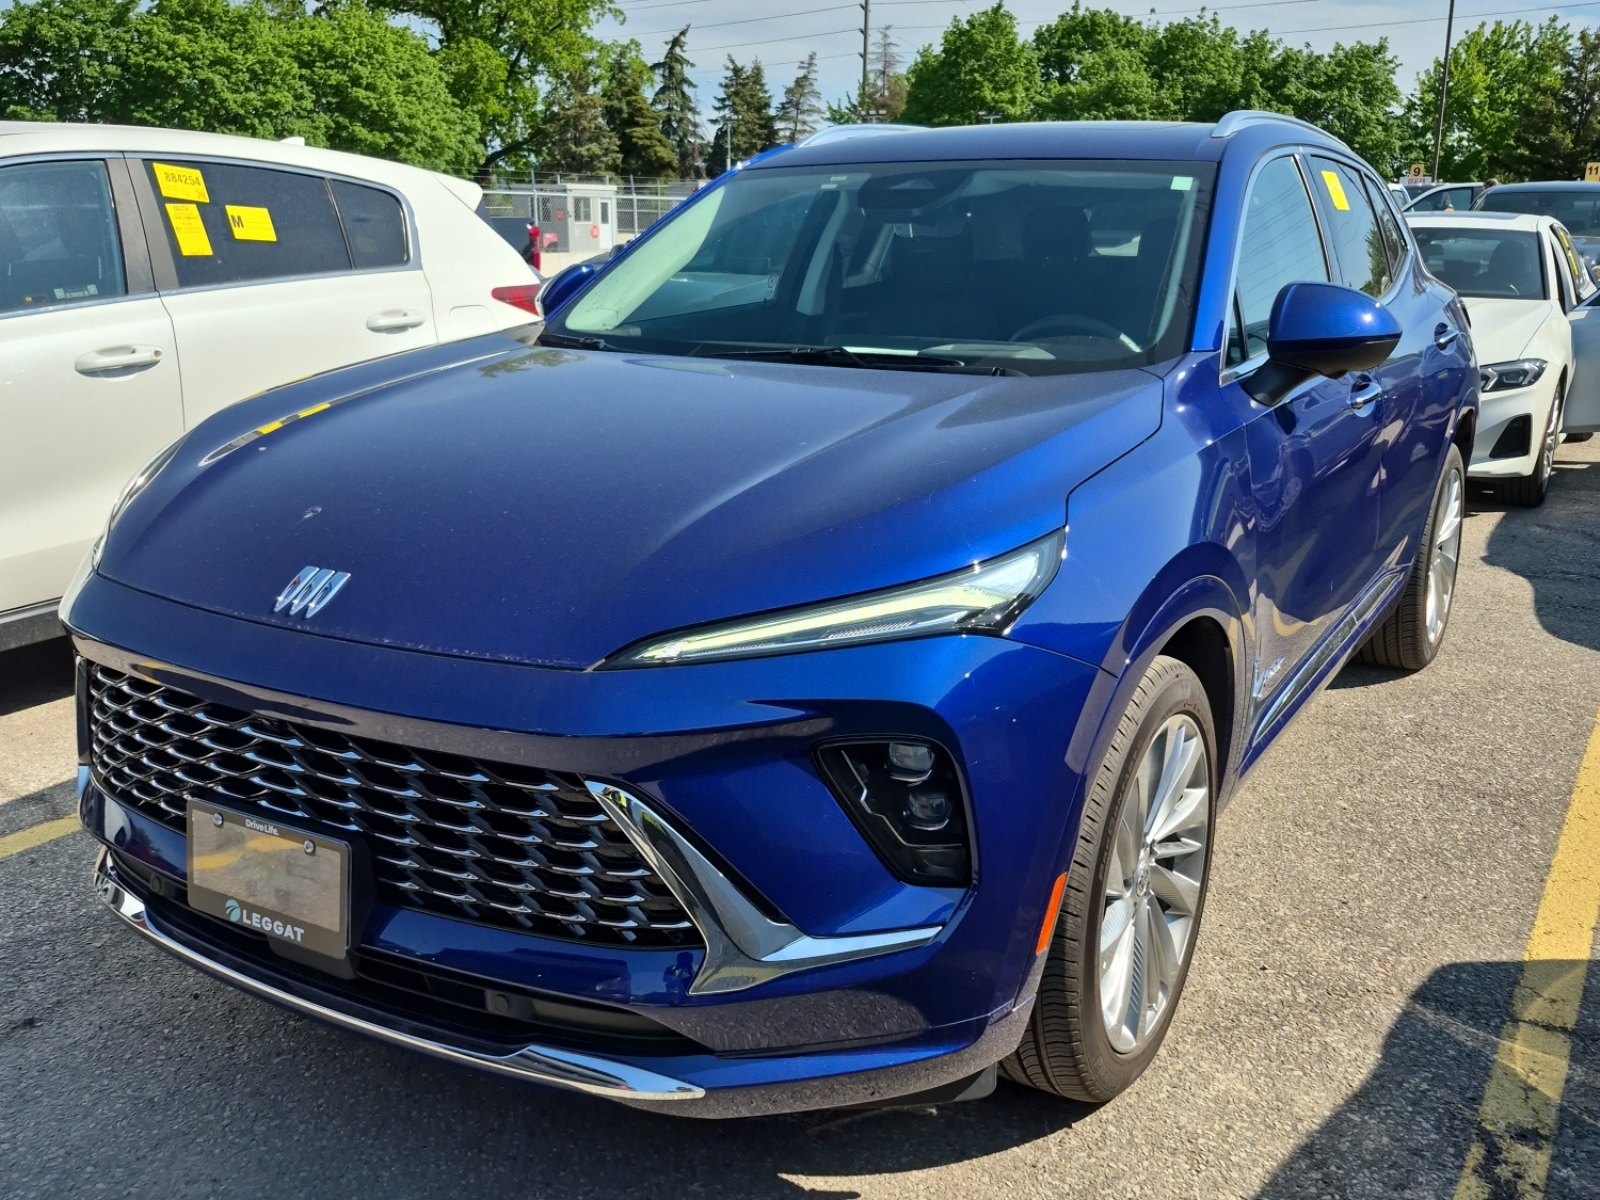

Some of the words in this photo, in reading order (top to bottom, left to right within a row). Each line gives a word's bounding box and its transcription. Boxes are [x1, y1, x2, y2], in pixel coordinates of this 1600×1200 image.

[1413, 167, 1421, 177] 9
[1588, 166, 1599, 175] 11
[164, 171, 201, 186] 884254
[231, 215, 244, 228] M
[245, 819, 263, 831] Drive
[242, 909, 304, 941] LEGGAT
